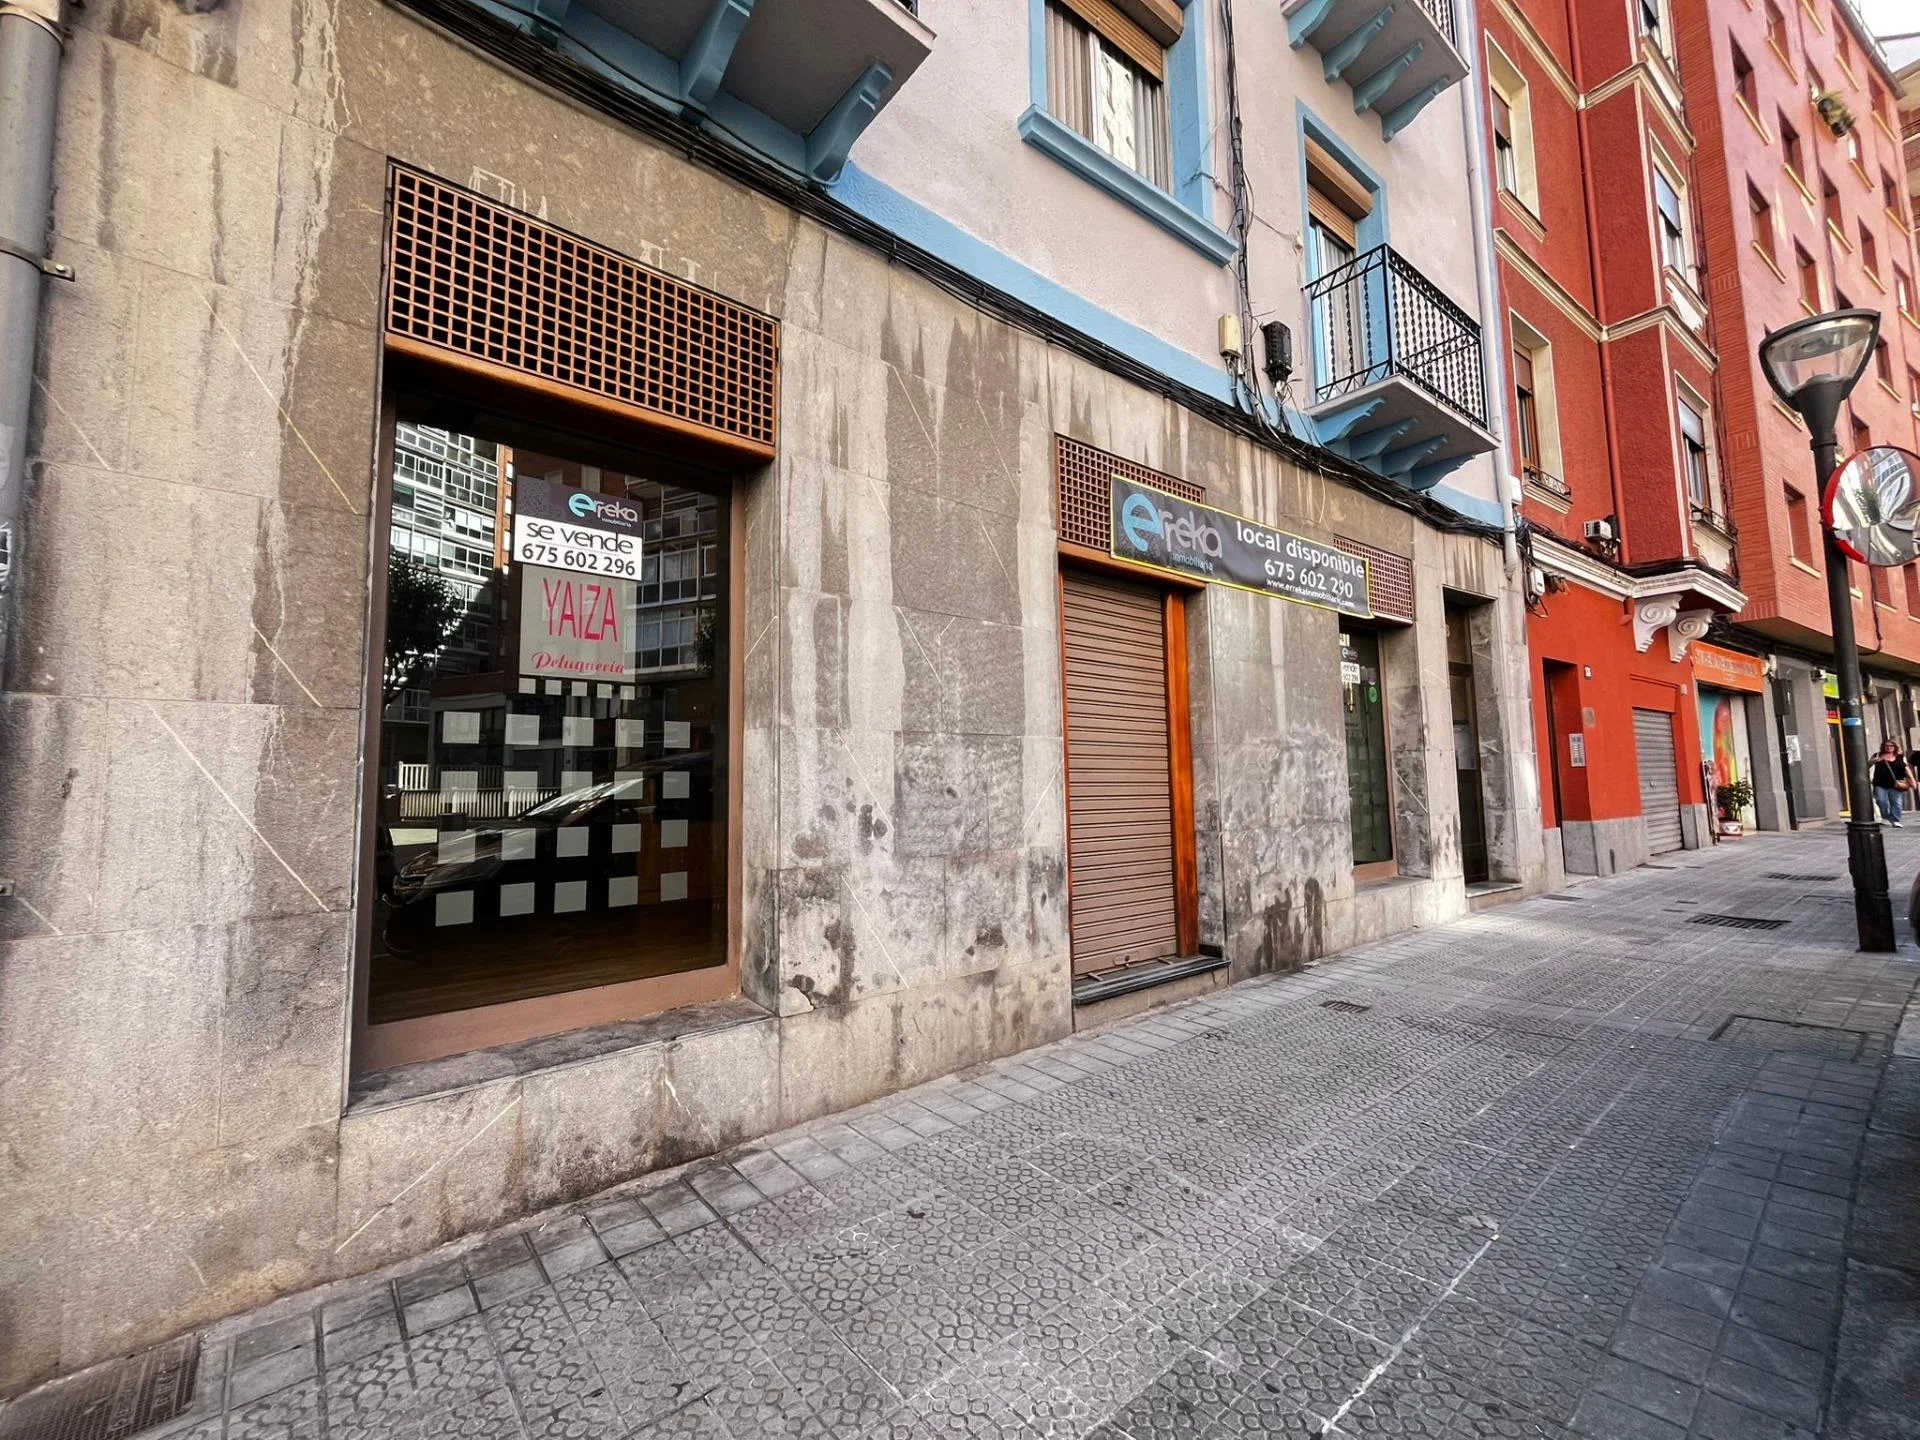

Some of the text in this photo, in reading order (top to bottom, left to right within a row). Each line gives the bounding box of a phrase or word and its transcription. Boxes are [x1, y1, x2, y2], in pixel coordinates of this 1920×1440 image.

[526, 522, 634, 555] se vende
[1236, 520, 1365, 578] local disponible
[522, 543, 636, 576] 675 602 296
[1264, 558, 1353, 598] 675 602 290
[543, 577, 618, 642] YAIZA
